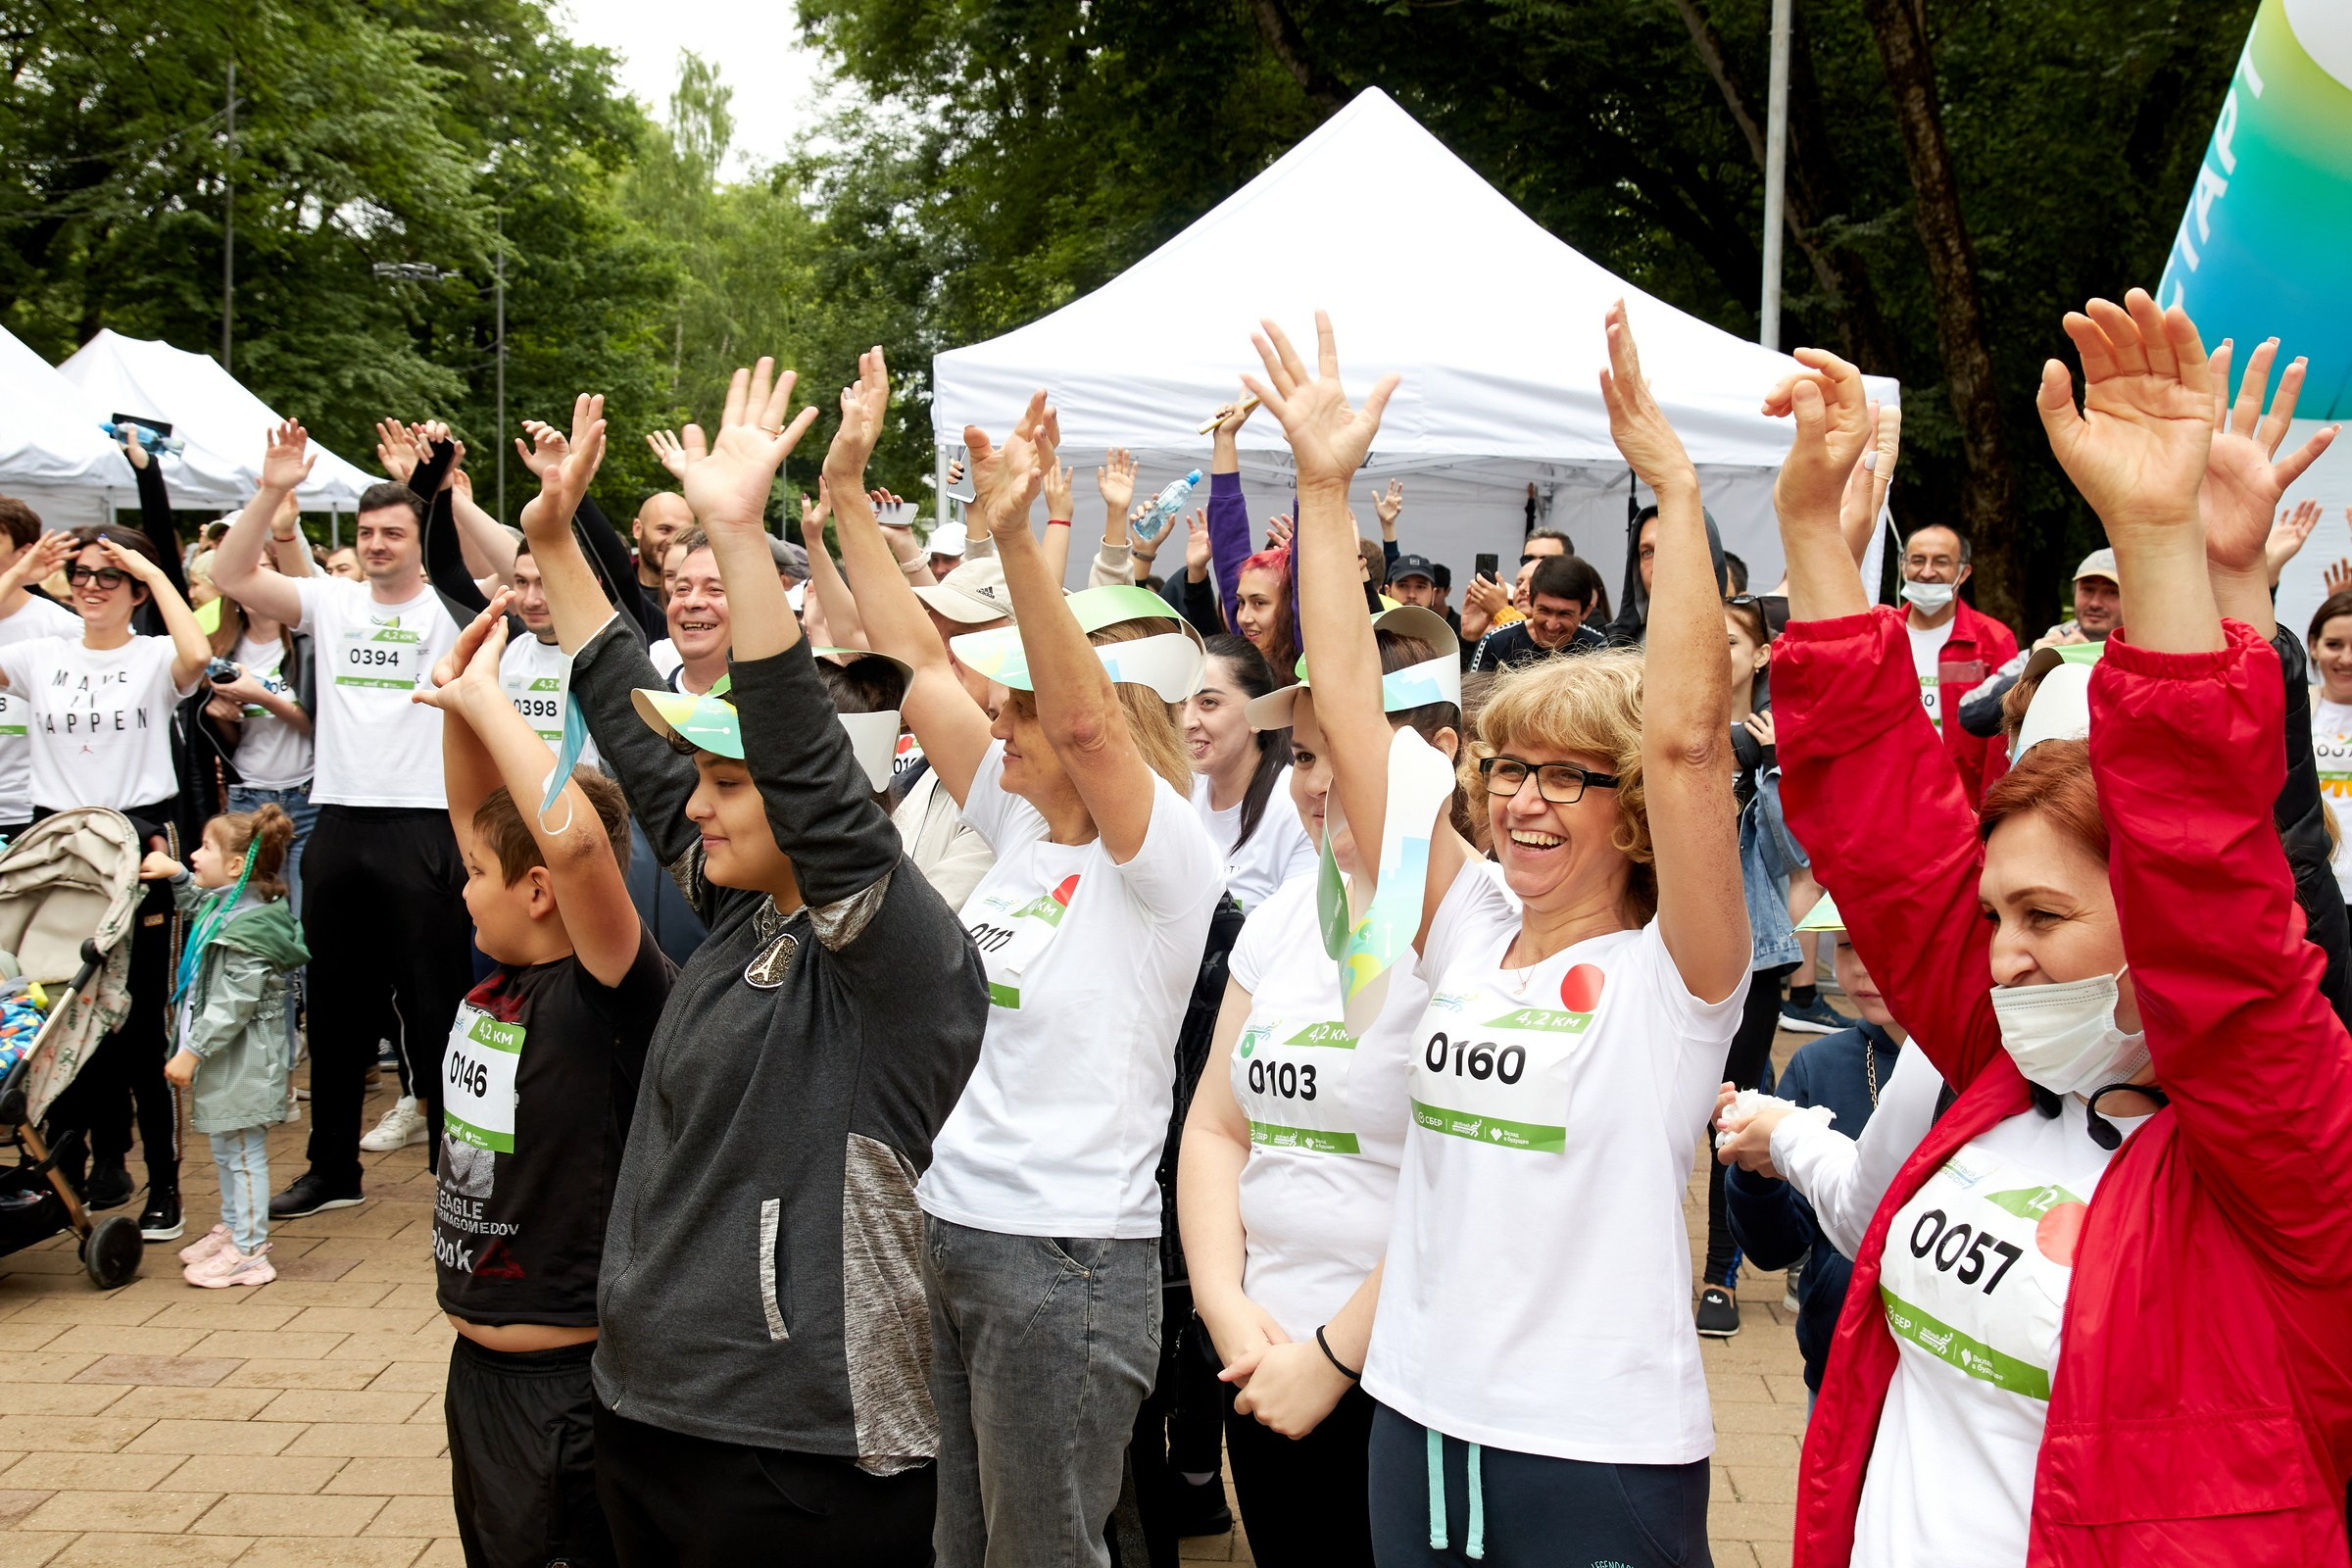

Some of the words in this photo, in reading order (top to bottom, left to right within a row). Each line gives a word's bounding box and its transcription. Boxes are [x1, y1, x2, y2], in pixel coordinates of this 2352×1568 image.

[383, 630, 398, 641] 4,2
[350, 649, 399, 666] 0394
[539, 679, 555, 690] 4,2
[514, 699, 557, 716] 0398
[894, 758, 917, 775] 01
[1515, 1010, 1550, 1027] 4,2
[1550, 1015, 1581, 1028] КМ
[479, 1020, 492, 1041] 4,2
[493, 1030, 514, 1046] КМ
[1308, 1024, 1330, 1045] 4,2
[1425, 1031, 1527, 1085] 0160
[450, 1051, 488, 1099] 0146
[1249, 1058, 1317, 1102] 0103
[440, 1189, 484, 1219] EAGLE
[1910, 1208, 2024, 1296] 0057
